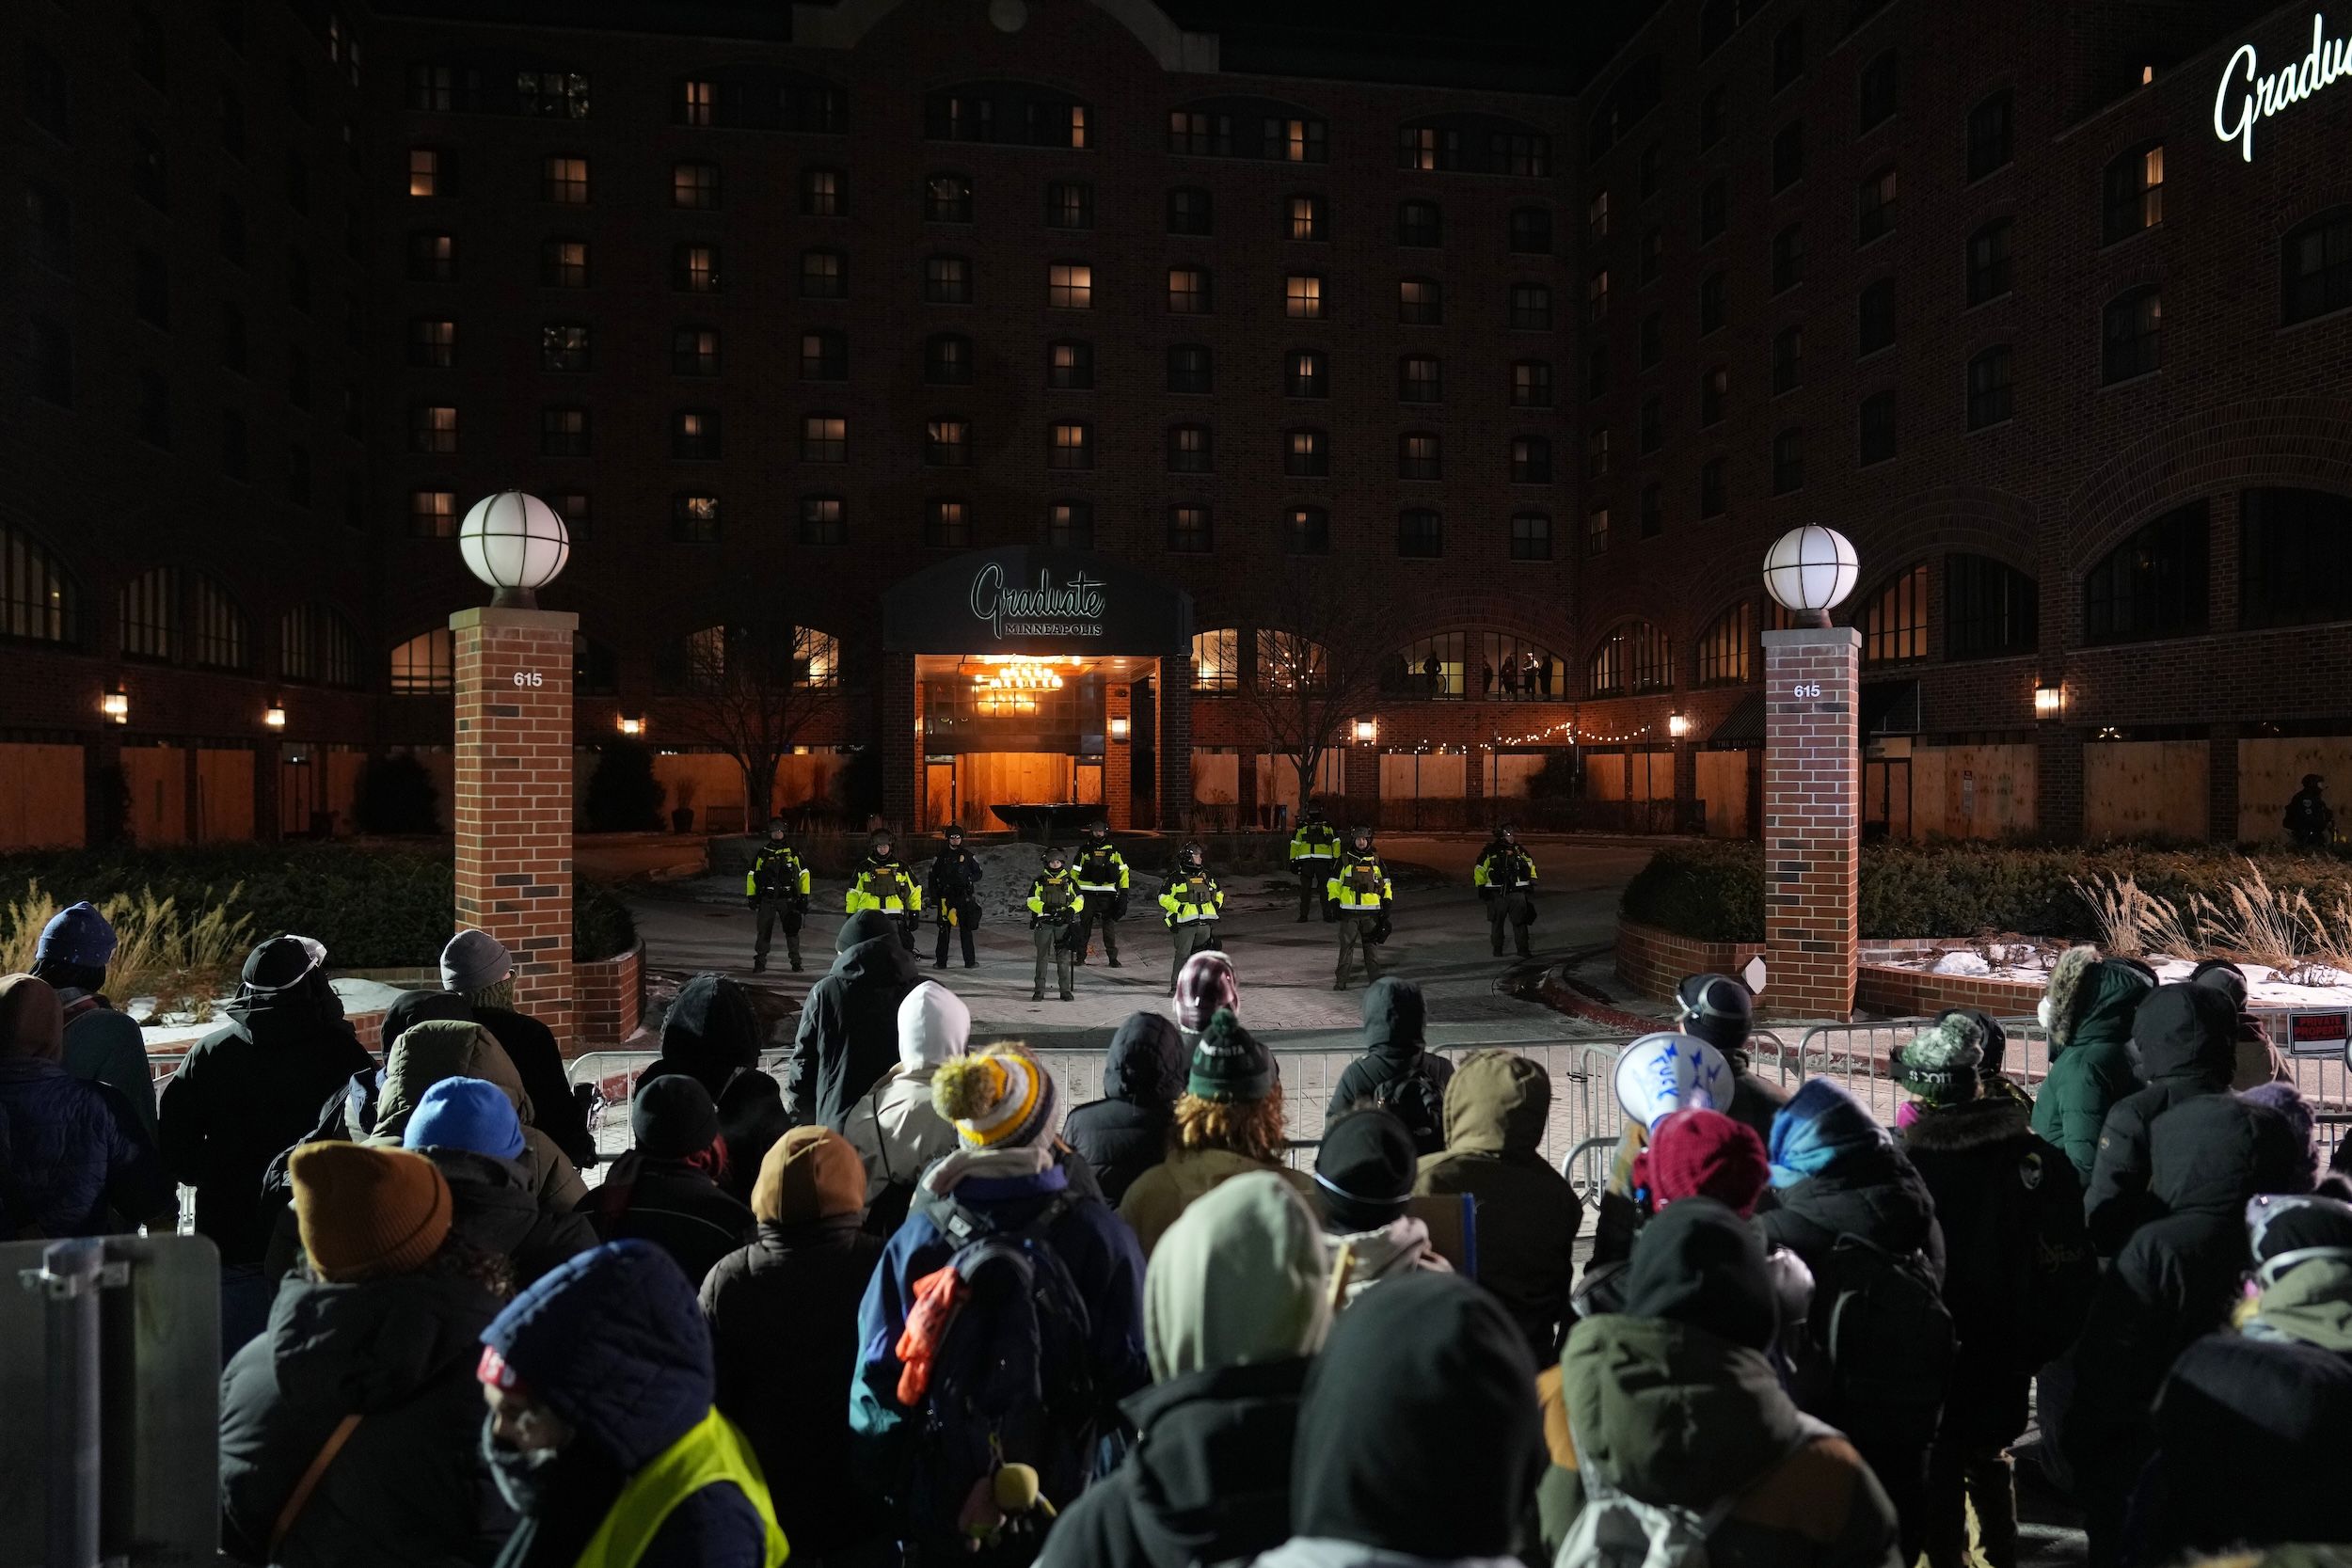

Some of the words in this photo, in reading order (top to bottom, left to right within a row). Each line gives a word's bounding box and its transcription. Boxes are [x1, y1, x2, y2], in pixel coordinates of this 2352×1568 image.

[2214, 12, 2352, 163] Gradu
[971, 562, 1106, 640] Graduate
[1005, 623, 1103, 636] MINNEAPOLIS
[514, 672, 543, 687] 615
[1794, 685, 1820, 697] 615
[2297, 1016, 2342, 1025] PRIVATE
